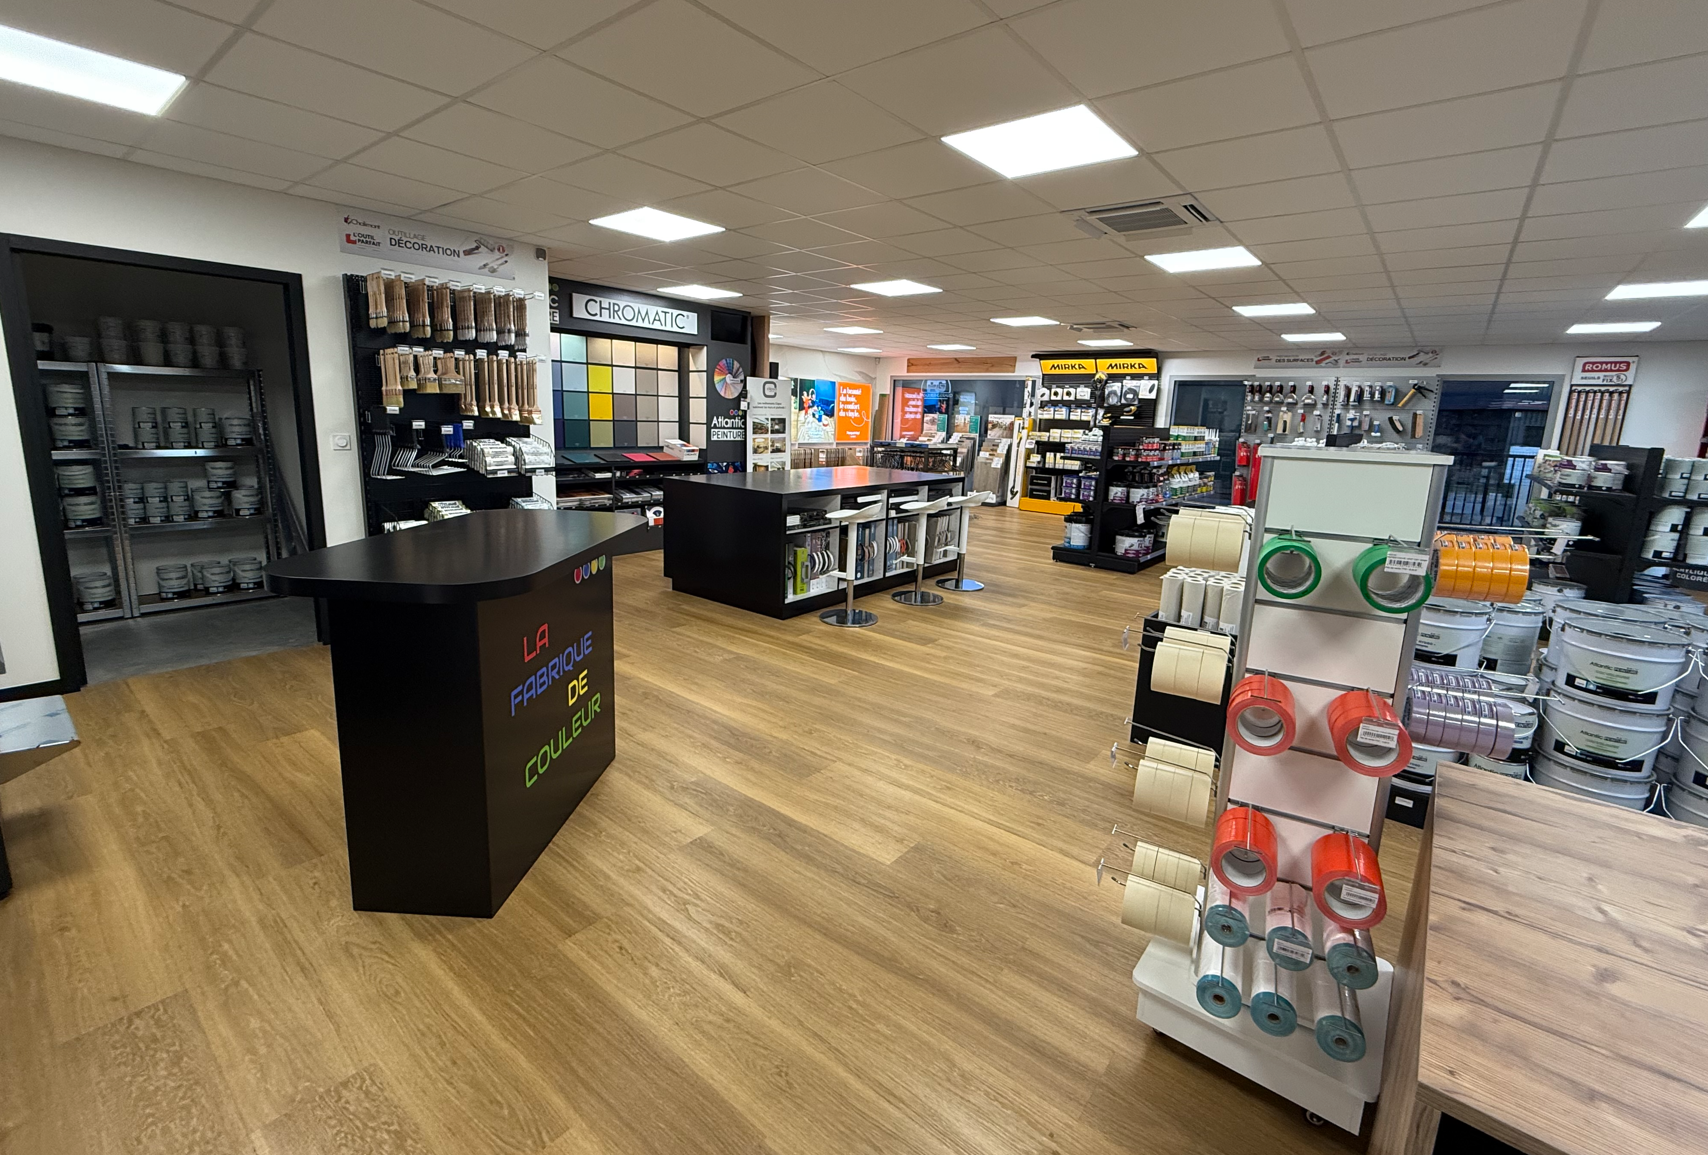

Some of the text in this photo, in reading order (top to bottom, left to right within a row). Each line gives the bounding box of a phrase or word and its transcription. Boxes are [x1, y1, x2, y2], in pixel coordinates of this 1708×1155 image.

[353, 232, 376, 240] L'OUTIL
[388, 228, 427, 242] OUTILLAGE
[357, 239, 381, 247] PARFAIT
[389, 237, 461, 258] DÉCORATION
[1049, 363, 1088, 371] MIRKA
[1106, 362, 1149, 370] MIRKA
[1584, 363, 1628, 371] ROMUS
[711, 416, 745, 428] Atlantic
[712, 431, 745, 440] PEINTURE
[523, 622, 550, 663] LA
[510, 631, 593, 717] FABRIQUE
[568, 669, 589, 707] DE
[525, 692, 601, 788] COULEUR
